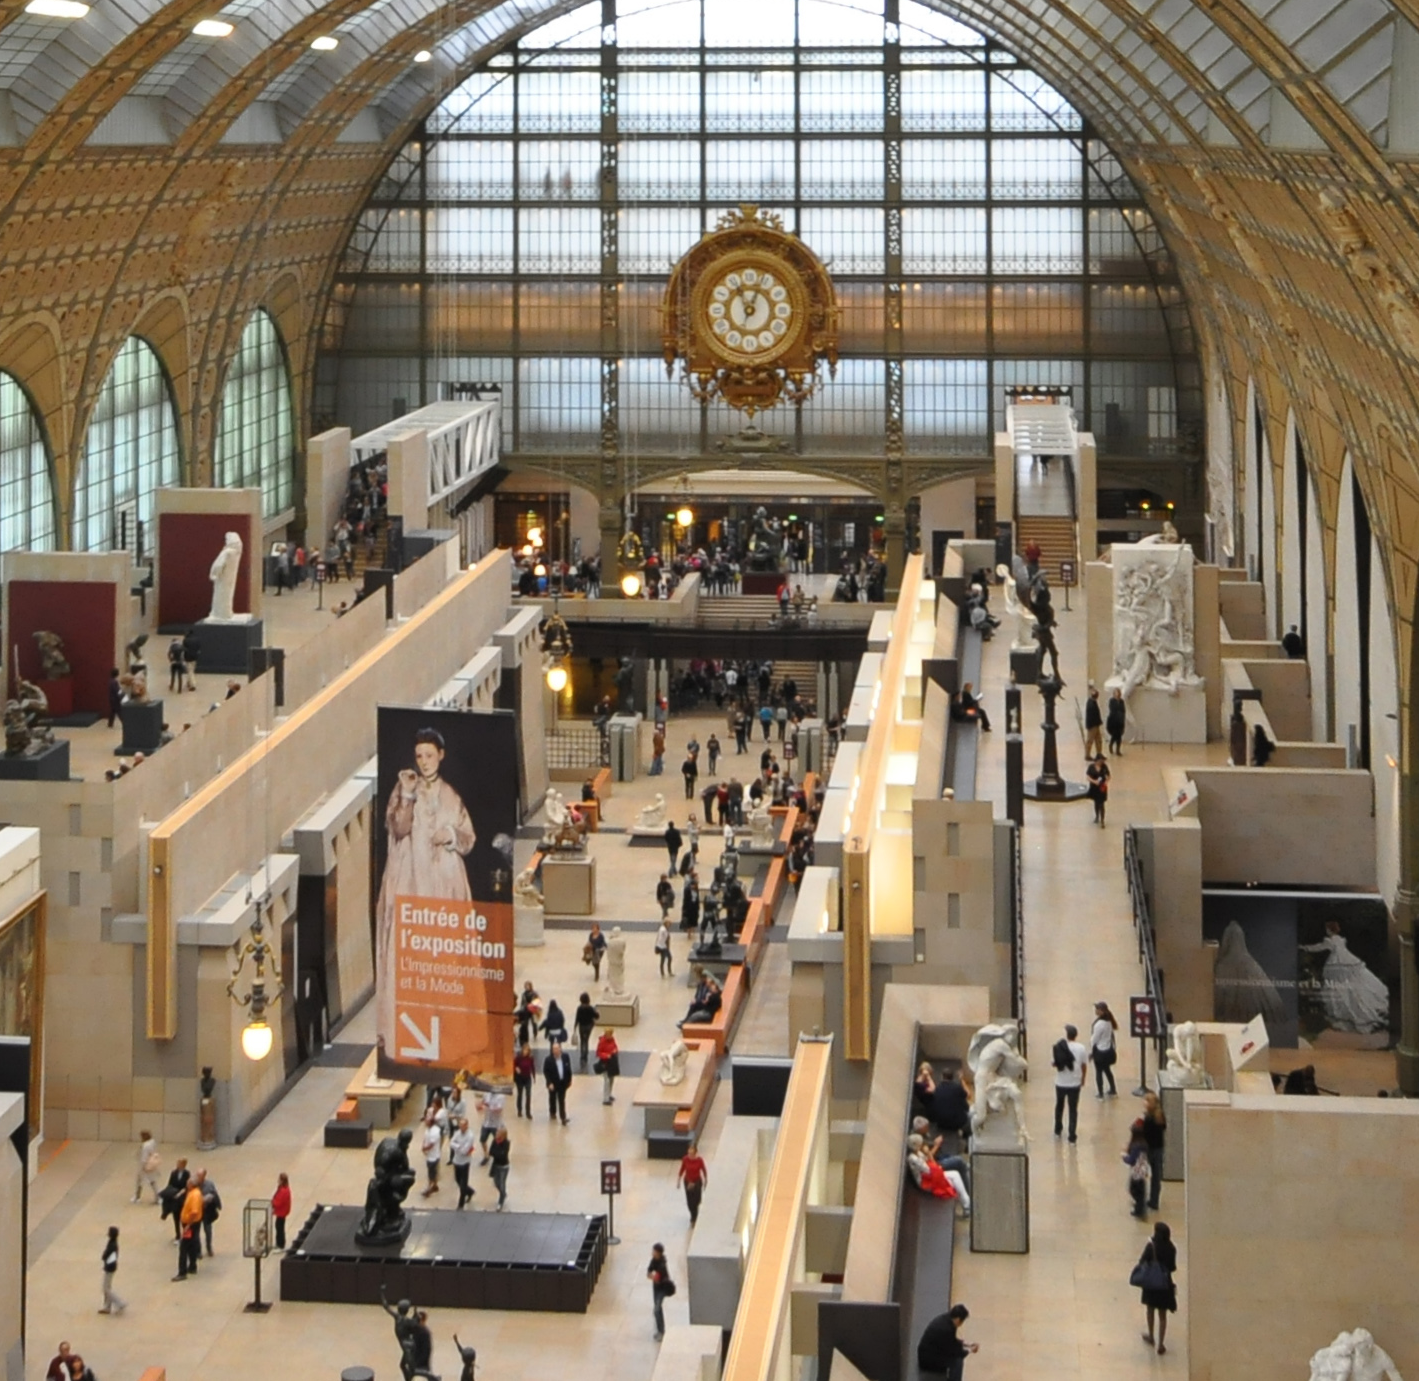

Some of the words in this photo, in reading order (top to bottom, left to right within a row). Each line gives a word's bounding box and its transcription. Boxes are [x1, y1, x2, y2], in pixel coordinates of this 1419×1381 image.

[401, 903, 459, 928] Entrée
[464, 909, 487, 931] de
[401, 928, 506, 958] l'exposition
[400, 957, 505, 981] L'Impressionnisme
[400, 977, 412, 989] et
[416, 976, 426, 991] la
[430, 977, 464, 995] Mode
